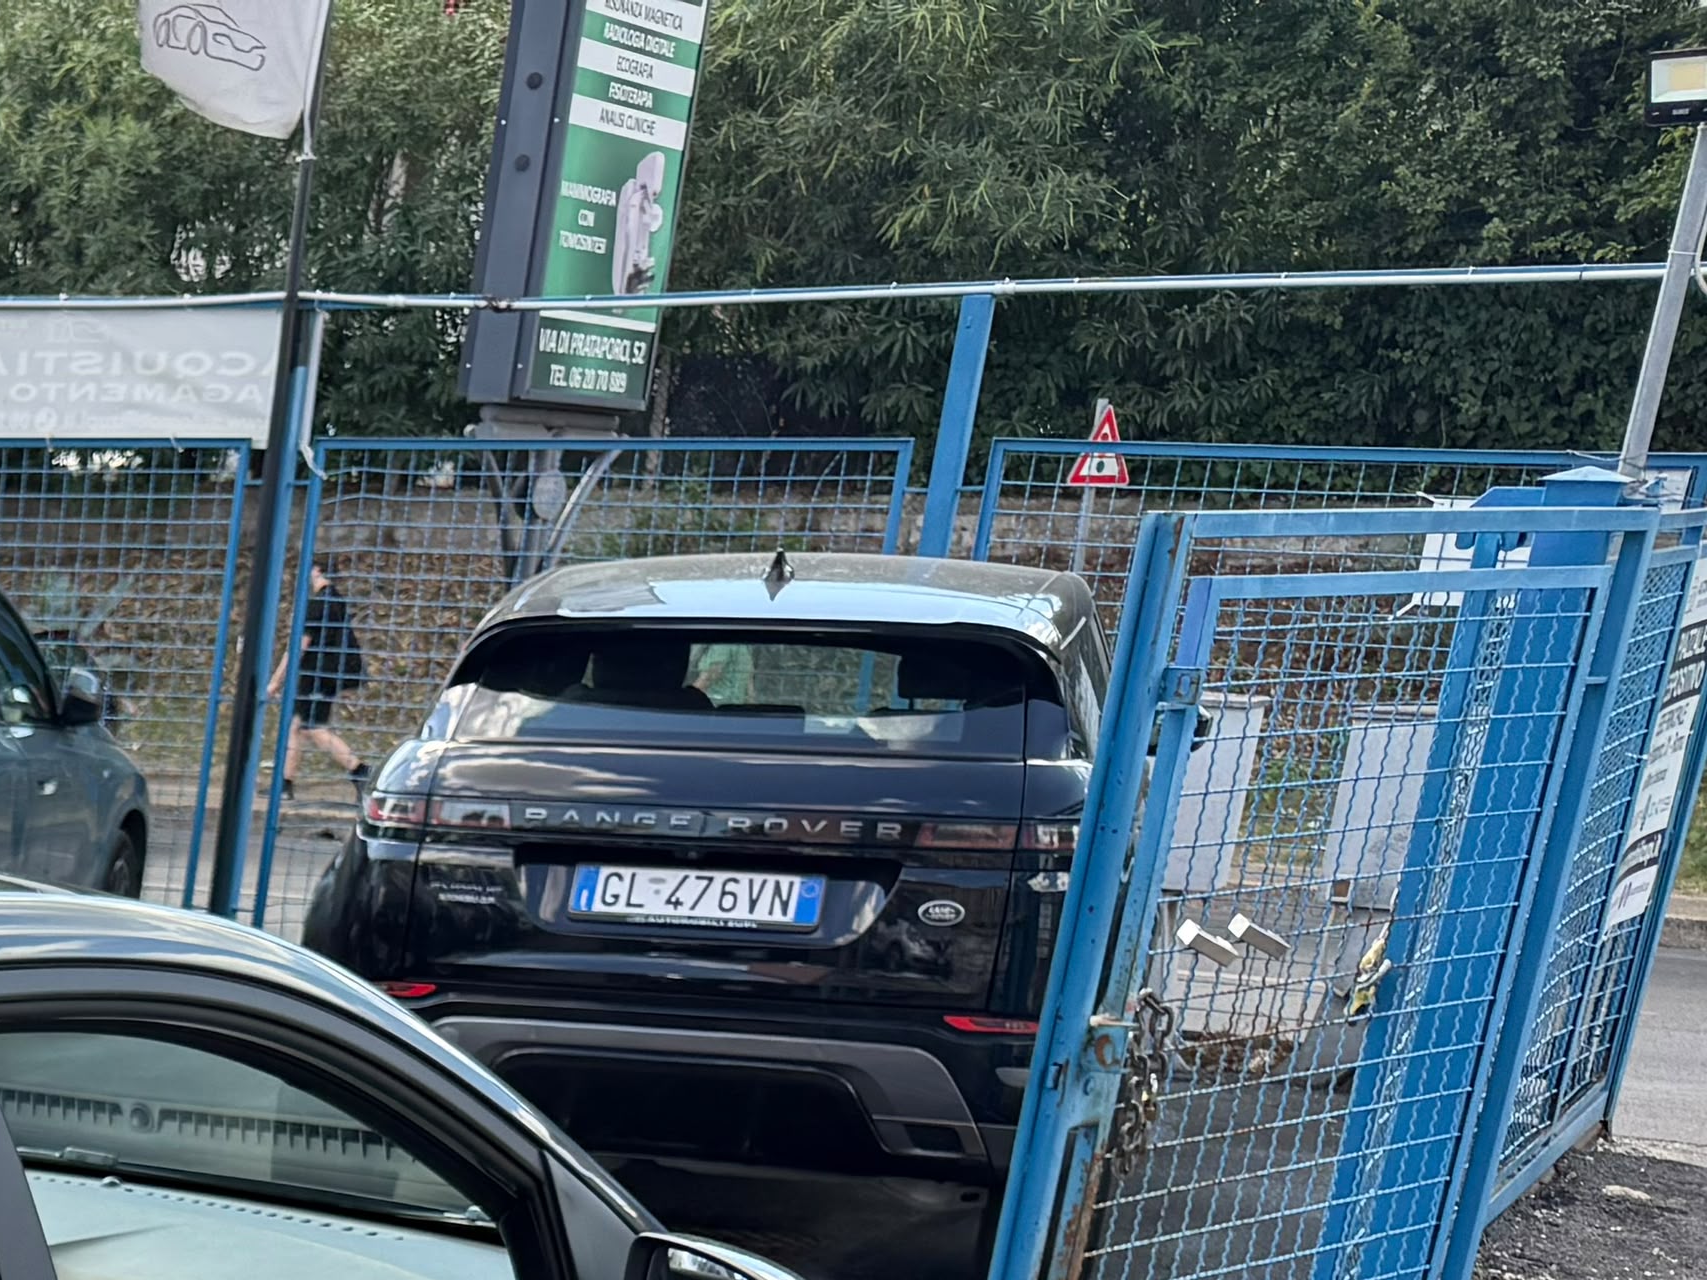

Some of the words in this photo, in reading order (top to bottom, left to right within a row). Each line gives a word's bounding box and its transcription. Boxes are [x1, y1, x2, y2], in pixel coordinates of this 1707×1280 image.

[603, 22, 645, 49] RADIOLOGIA
[616, 55, 654, 79] ECOGRAFIA
[538, 328, 557, 352] VIA
[631, 341, 647, 365] 52
[524, 807, 693, 830] RANGE
[728, 816, 903, 840] ROVER
[601, 872, 645, 910] GL
[664, 873, 795, 919] 476VN
